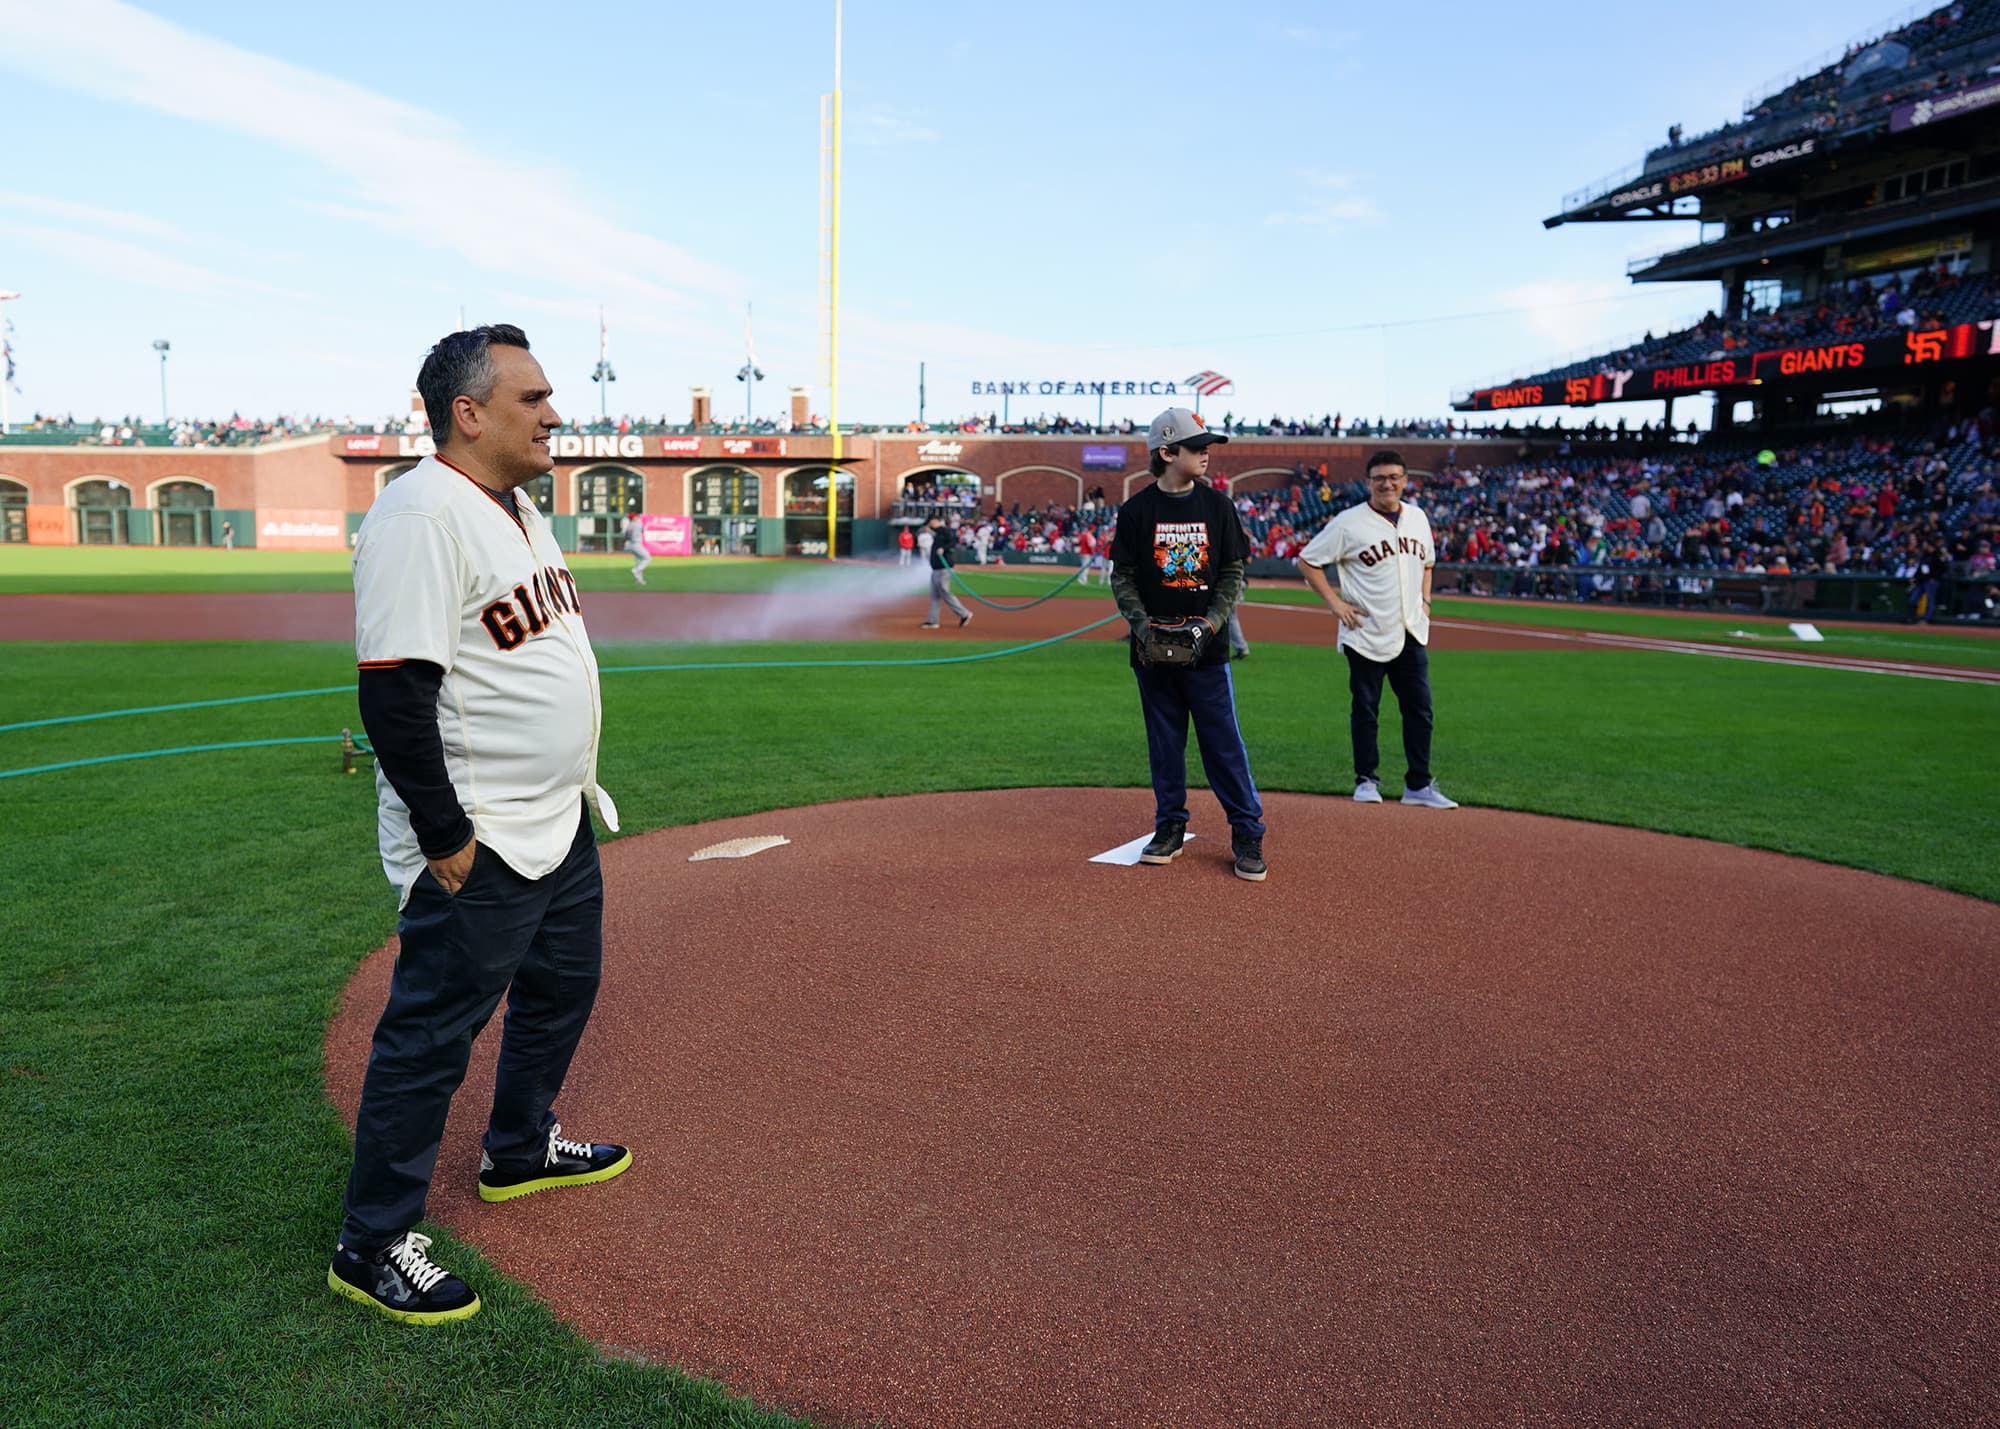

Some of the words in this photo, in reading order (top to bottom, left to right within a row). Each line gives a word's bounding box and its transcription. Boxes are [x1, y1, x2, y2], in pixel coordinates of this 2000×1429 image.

[1779, 342, 1865, 375] GIANTS
[971, 381, 1031, 395] BANK
[1039, 381, 1068, 395] OF
[1073, 381, 1178, 395] AMERICA
[1653, 360, 1736, 390] PHILLIES
[1490, 385, 1544, 409] GIANTS
[1154, 532, 1208, 546] POWER
[1155, 522, 1207, 533] INFINITE
[1358, 536, 1426, 567] GIANTS
[480, 566, 583, 651] GIANT
